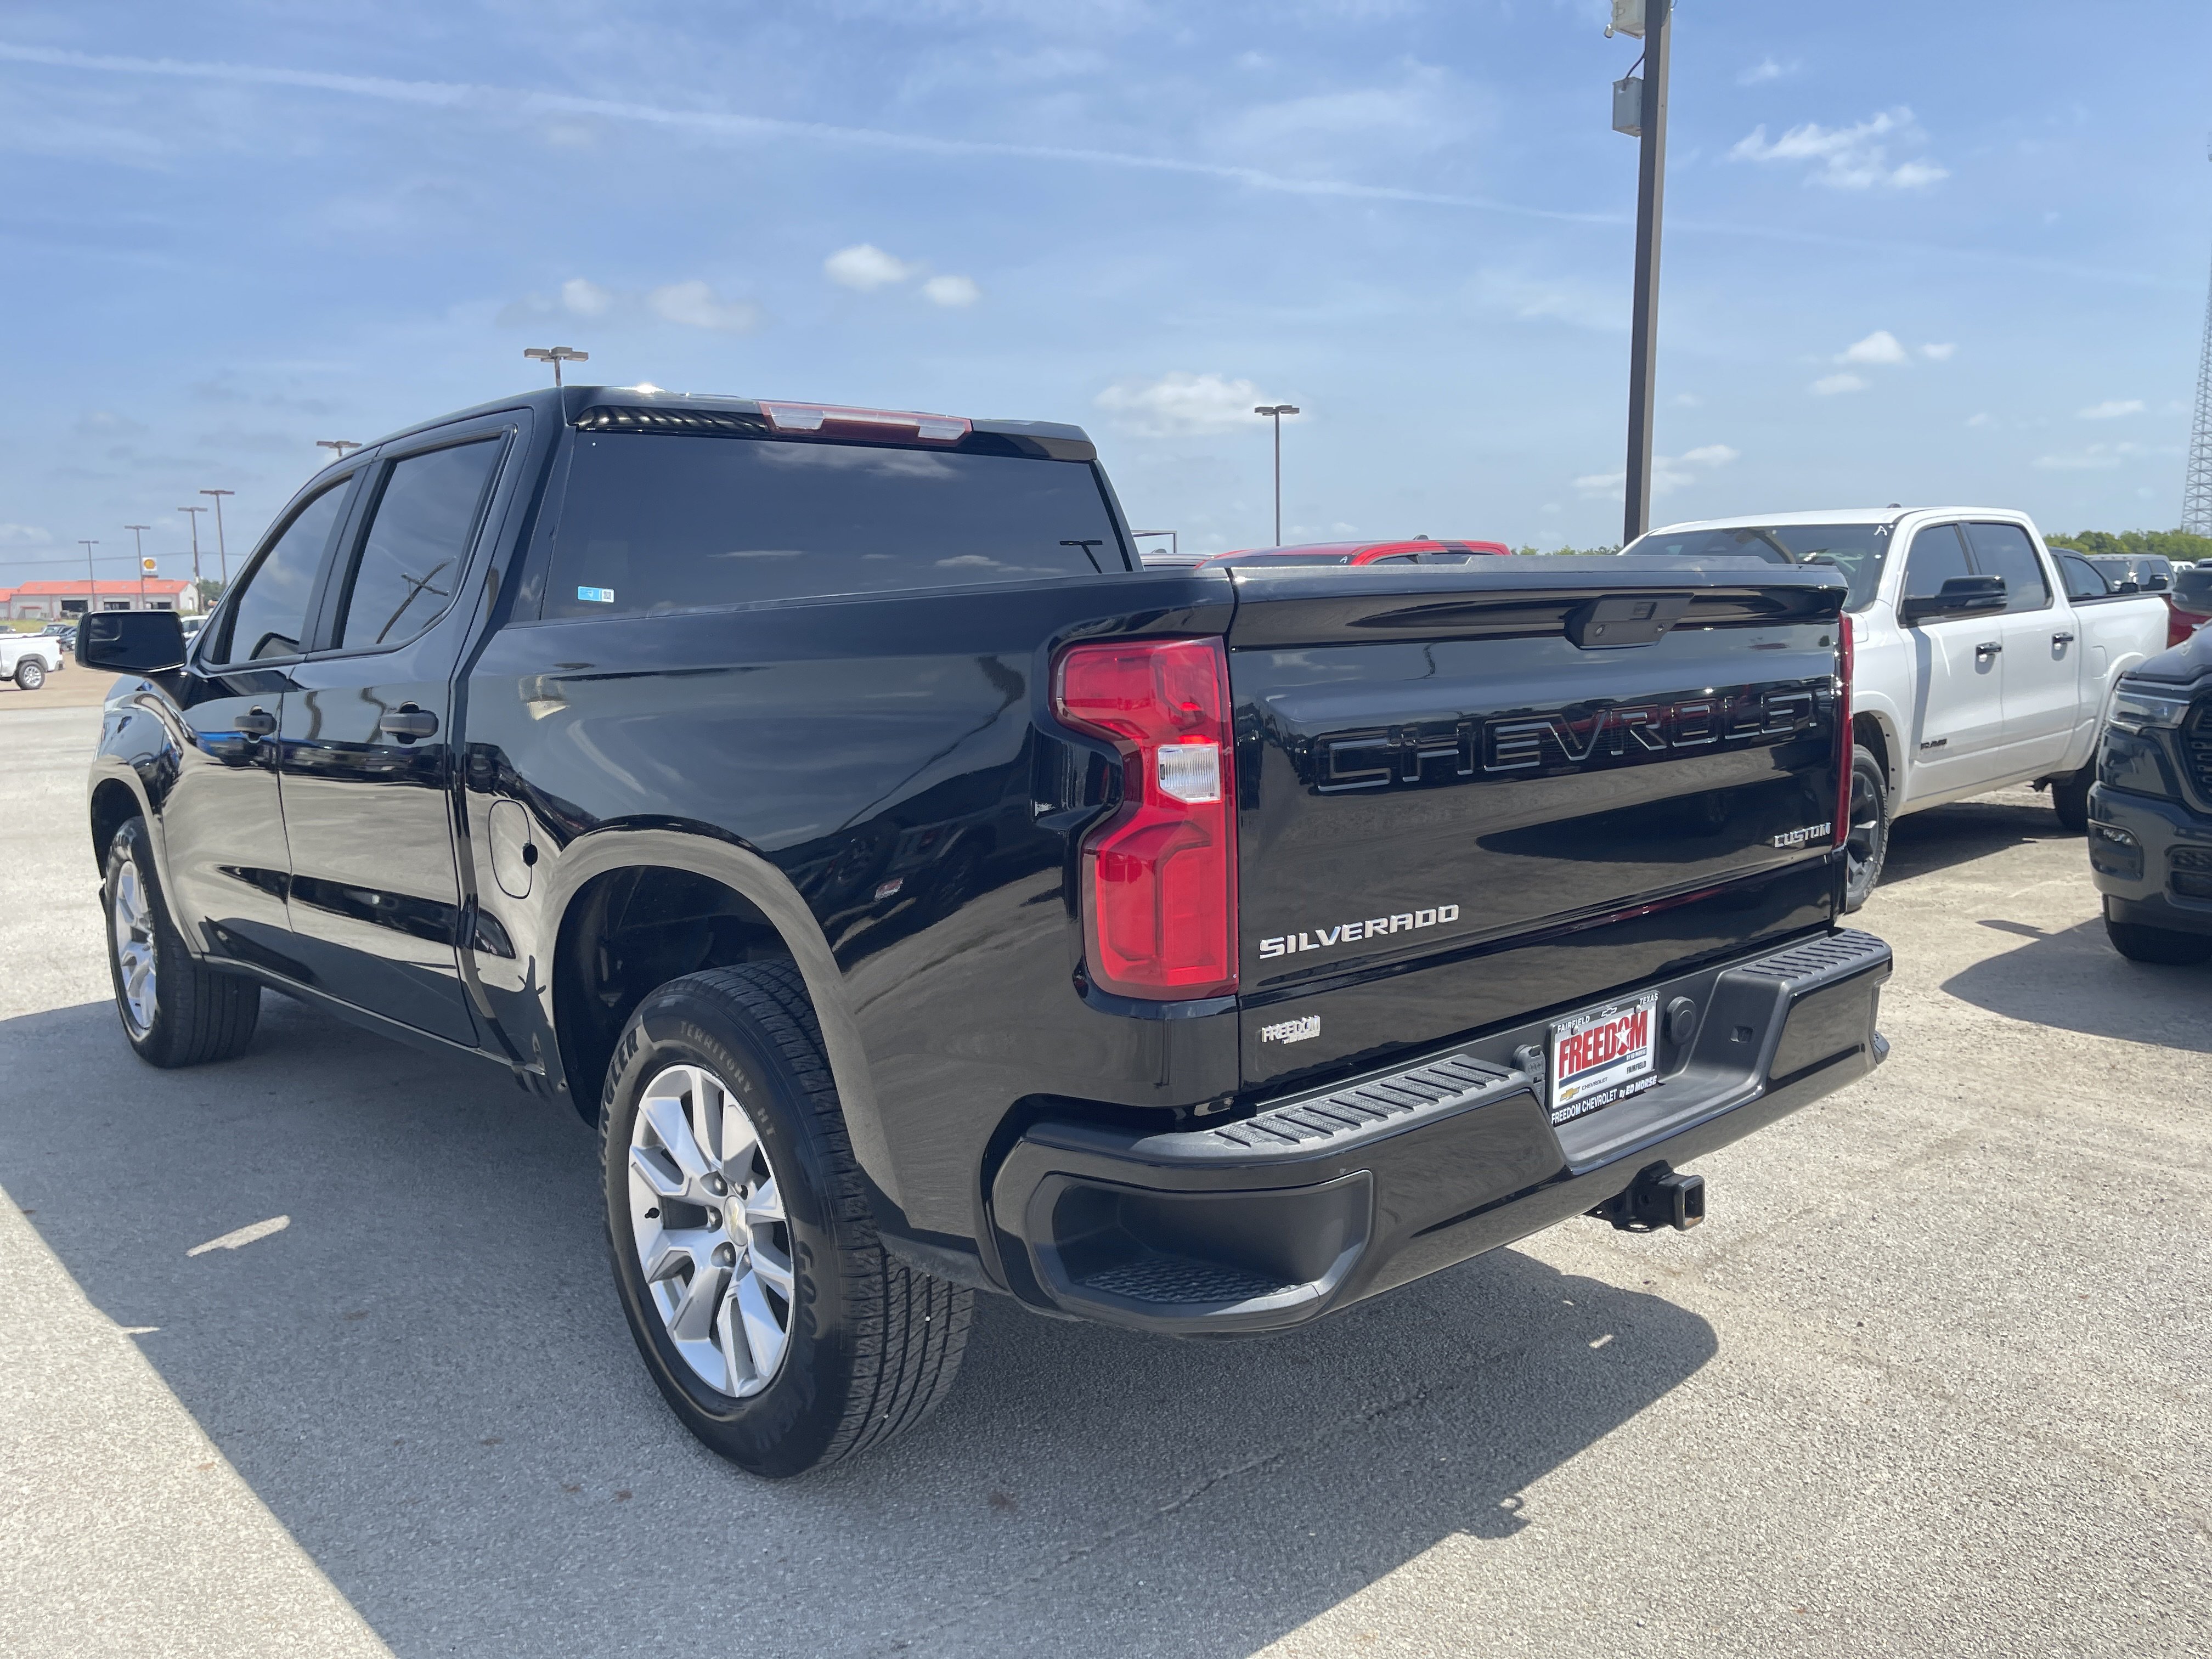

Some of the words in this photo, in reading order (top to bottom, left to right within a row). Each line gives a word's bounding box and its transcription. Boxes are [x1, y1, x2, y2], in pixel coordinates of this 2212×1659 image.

[1874, 525, 1888, 536] A
[1317, 680, 1833, 792] CHEVROLET
[1774, 822, 1831, 848] CUSTOM
[1259, 904, 1459, 959] SILVERADO
[1639, 993, 1658, 1005] TEXAS
[1261, 1015, 1321, 1042] FREEDOM
[1557, 1015, 1590, 1033] FAIRFIELD
[680, 1021, 754, 1093] TERRITORY
[1559, 1009, 1648, 1079] FREEDOM
[1627, 1060, 1646, 1074] FAIRFIELD
[1582, 1076, 1608, 1090] CHEVROLET
[1551, 1105, 1581, 1125] FREEDOM
[1582, 1088, 1618, 1112] CHEVROLET
[1626, 1084, 1634, 1095] ED
[1635, 1075, 1657, 1092] MORSE
